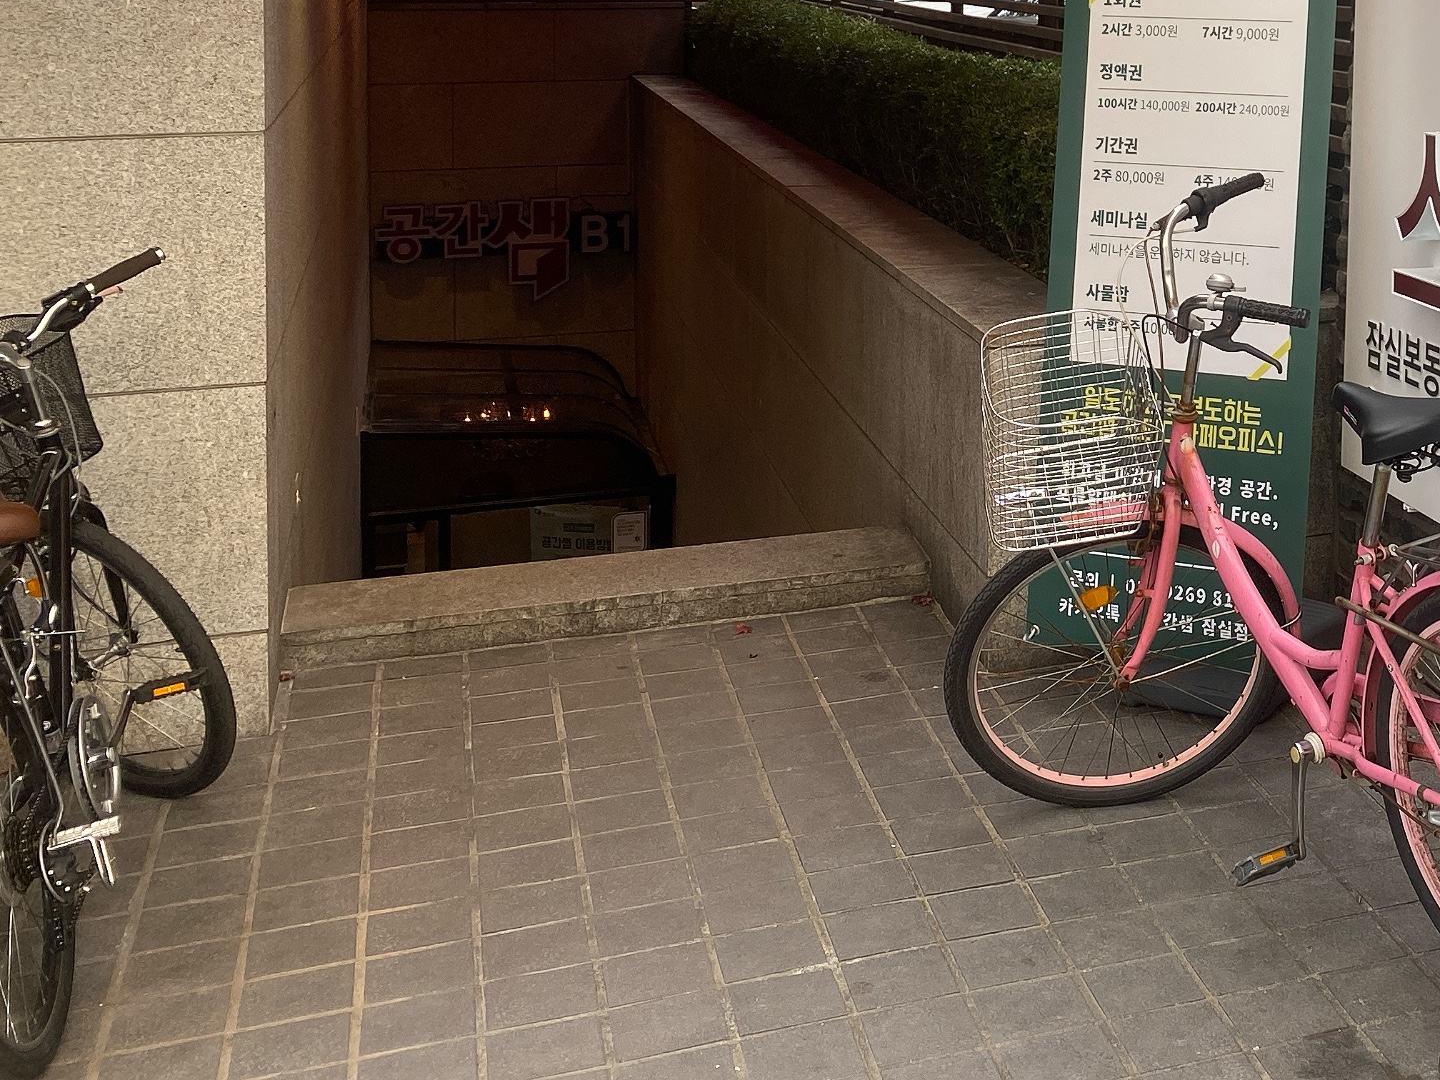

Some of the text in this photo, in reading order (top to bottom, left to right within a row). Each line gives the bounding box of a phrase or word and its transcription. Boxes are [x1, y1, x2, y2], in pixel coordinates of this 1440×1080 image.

[1101, 23, 1279, 42] 2시간 3,000원 7시간 9,000원
[1099, 63, 1142, 81] 정액권
[1097, 97, 1290, 117] 100시간 140,000원 200시간 240,000원
[1095, 136, 1138, 154] 기간권
[1093, 169, 1112, 183] 2주
[1115, 171, 1165, 185] 80,000원
[1194, 174, 1214, 188] 4주
[1090, 209, 1148, 230] 세미나실
[375, 197, 631, 301] 공간샘 B1
[1150, 245, 1196, 262] 운하지
[1199, 249, 1250, 266] 않습니다.
[1086, 283, 1130, 303] 사물함
[1239, 479, 1278, 500] 공간.
[1231, 505, 1279, 531] Free,
